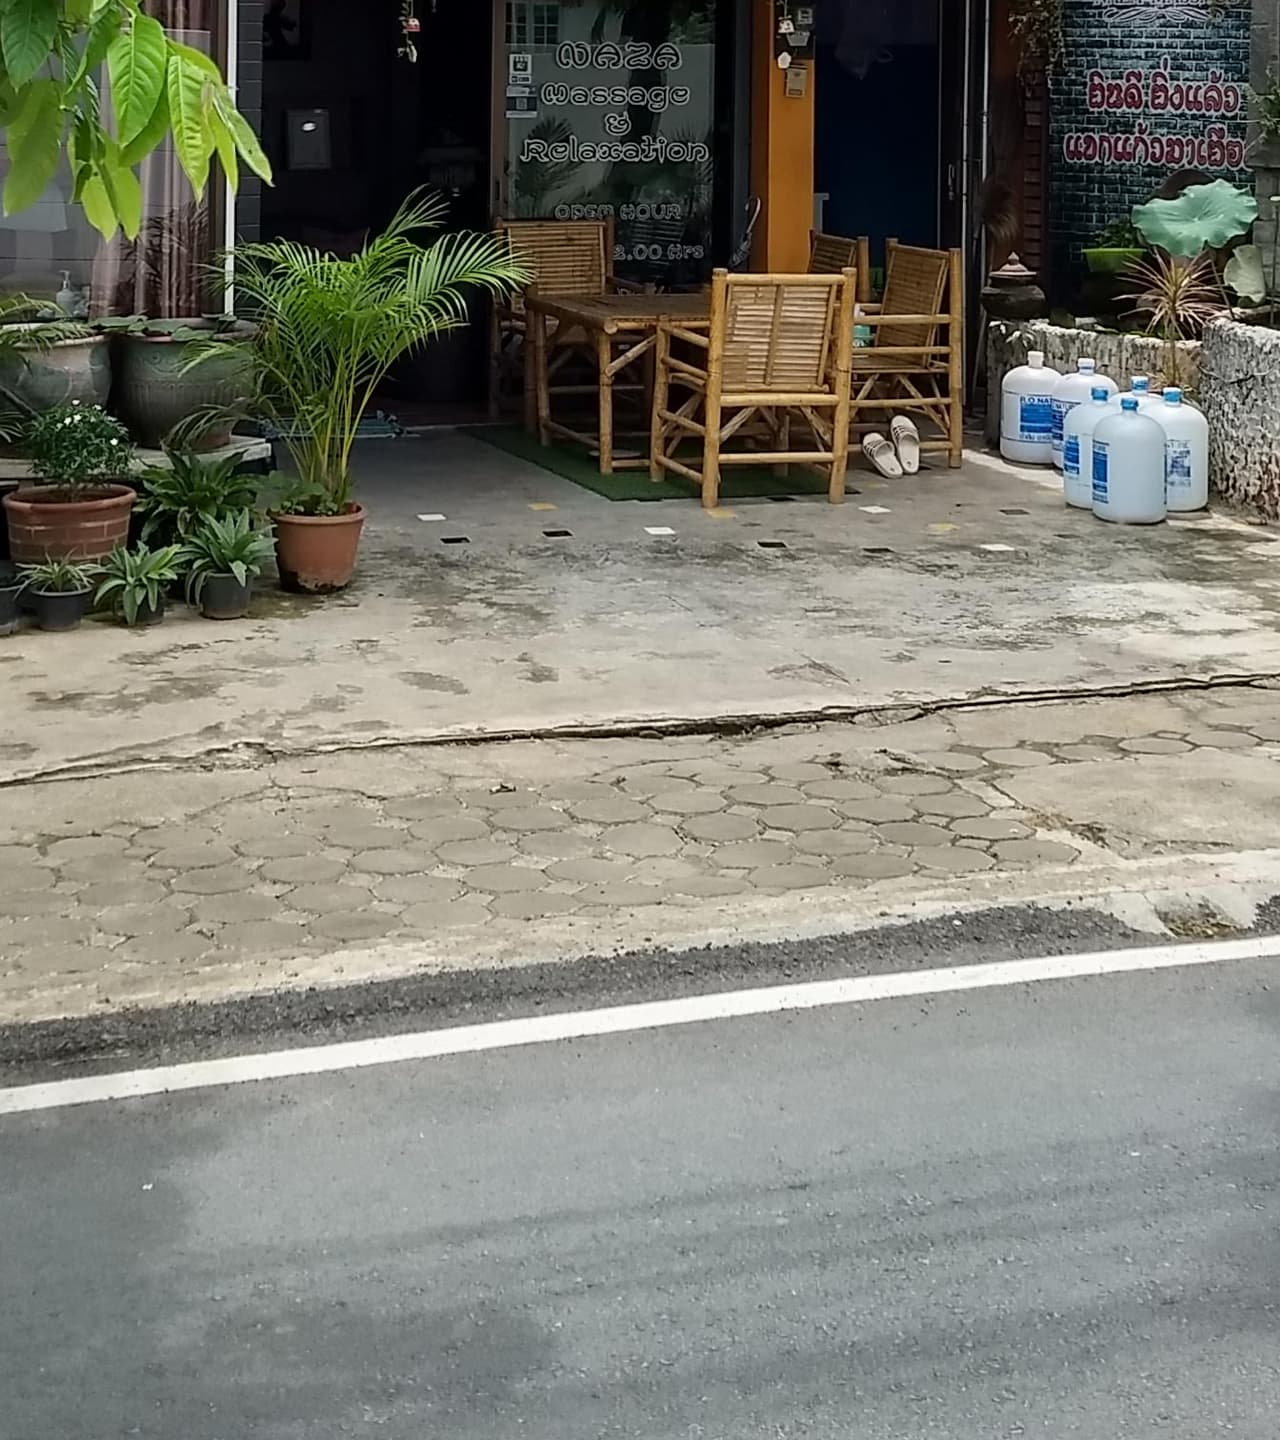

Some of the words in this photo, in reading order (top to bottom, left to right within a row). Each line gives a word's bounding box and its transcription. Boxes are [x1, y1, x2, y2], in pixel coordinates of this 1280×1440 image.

[556, 39, 683, 70] NAZA
[541, 82, 691, 112] Massage
[604, 111, 632, 135] &
[519, 134, 710, 164] Relaxation
[620, 203, 682, 221] HOUR
